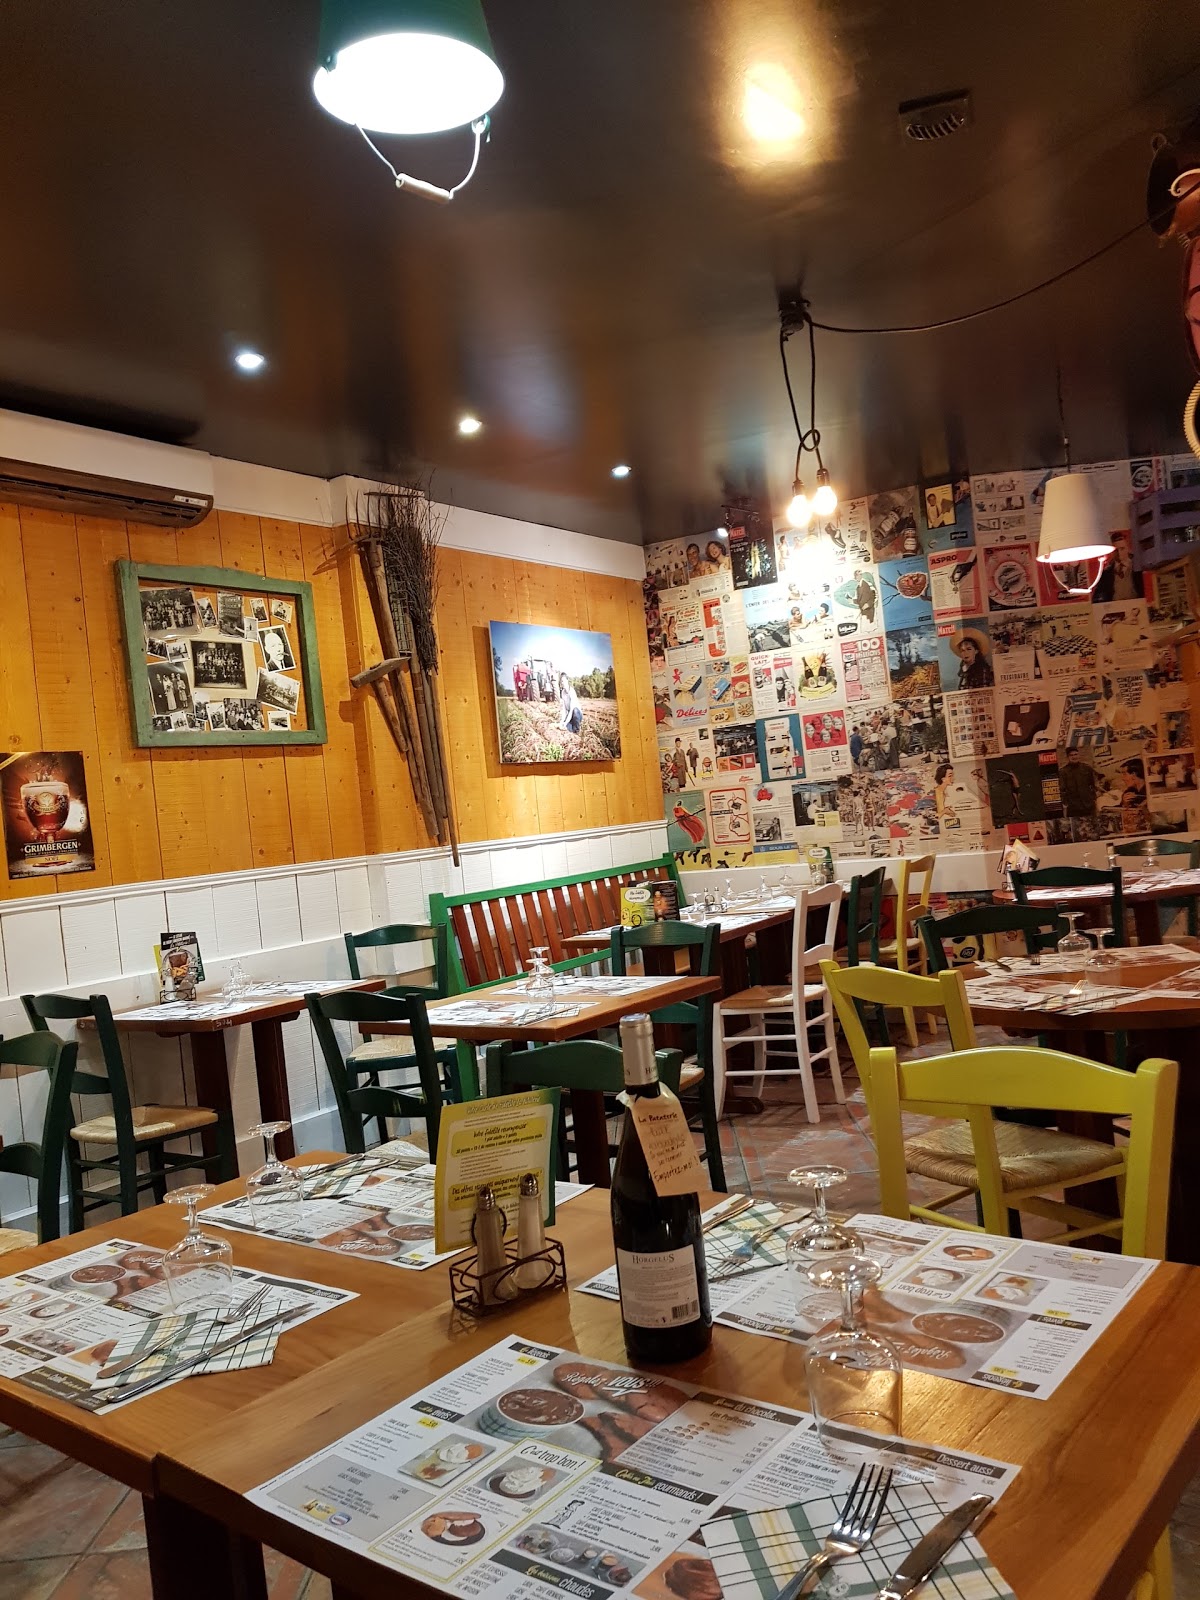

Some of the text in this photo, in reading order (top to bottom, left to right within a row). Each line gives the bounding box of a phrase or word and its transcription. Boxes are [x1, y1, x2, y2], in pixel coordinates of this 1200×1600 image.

[930, 554, 957, 565] ASPRO
[676, 707, 707, 718] Délices
[24, 841, 78, 854] GRIMBERGEN
[535, 1449, 562, 1464] trop
[556, 1454, 581, 1468] bon
[572, 1459, 587, 1471] !
[935, 1453, 973, 1469] Dessert
[968, 1462, 996, 1475] aussi
[652, 1480, 698, 1501] gourmands
[558, 1575, 598, 1598] chaudes
